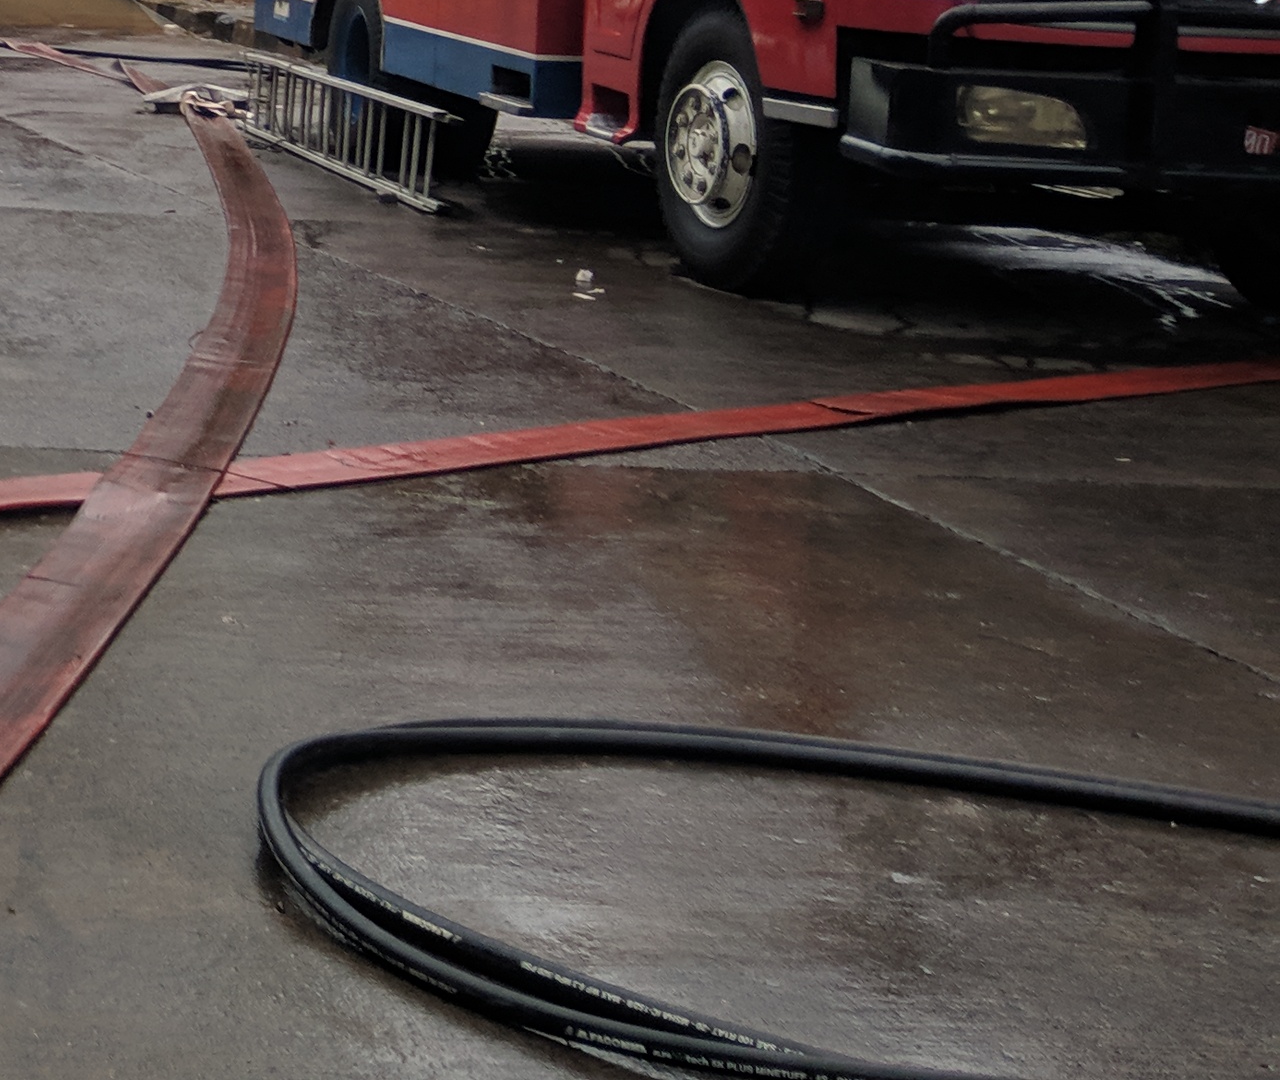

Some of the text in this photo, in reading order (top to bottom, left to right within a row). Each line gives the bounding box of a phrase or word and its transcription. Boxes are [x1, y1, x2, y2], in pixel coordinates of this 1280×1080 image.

[737, 1034, 754, 1046] 100
[756, 1039, 777, 1052] SAE
[726, 1061, 754, 1074] PLUS
